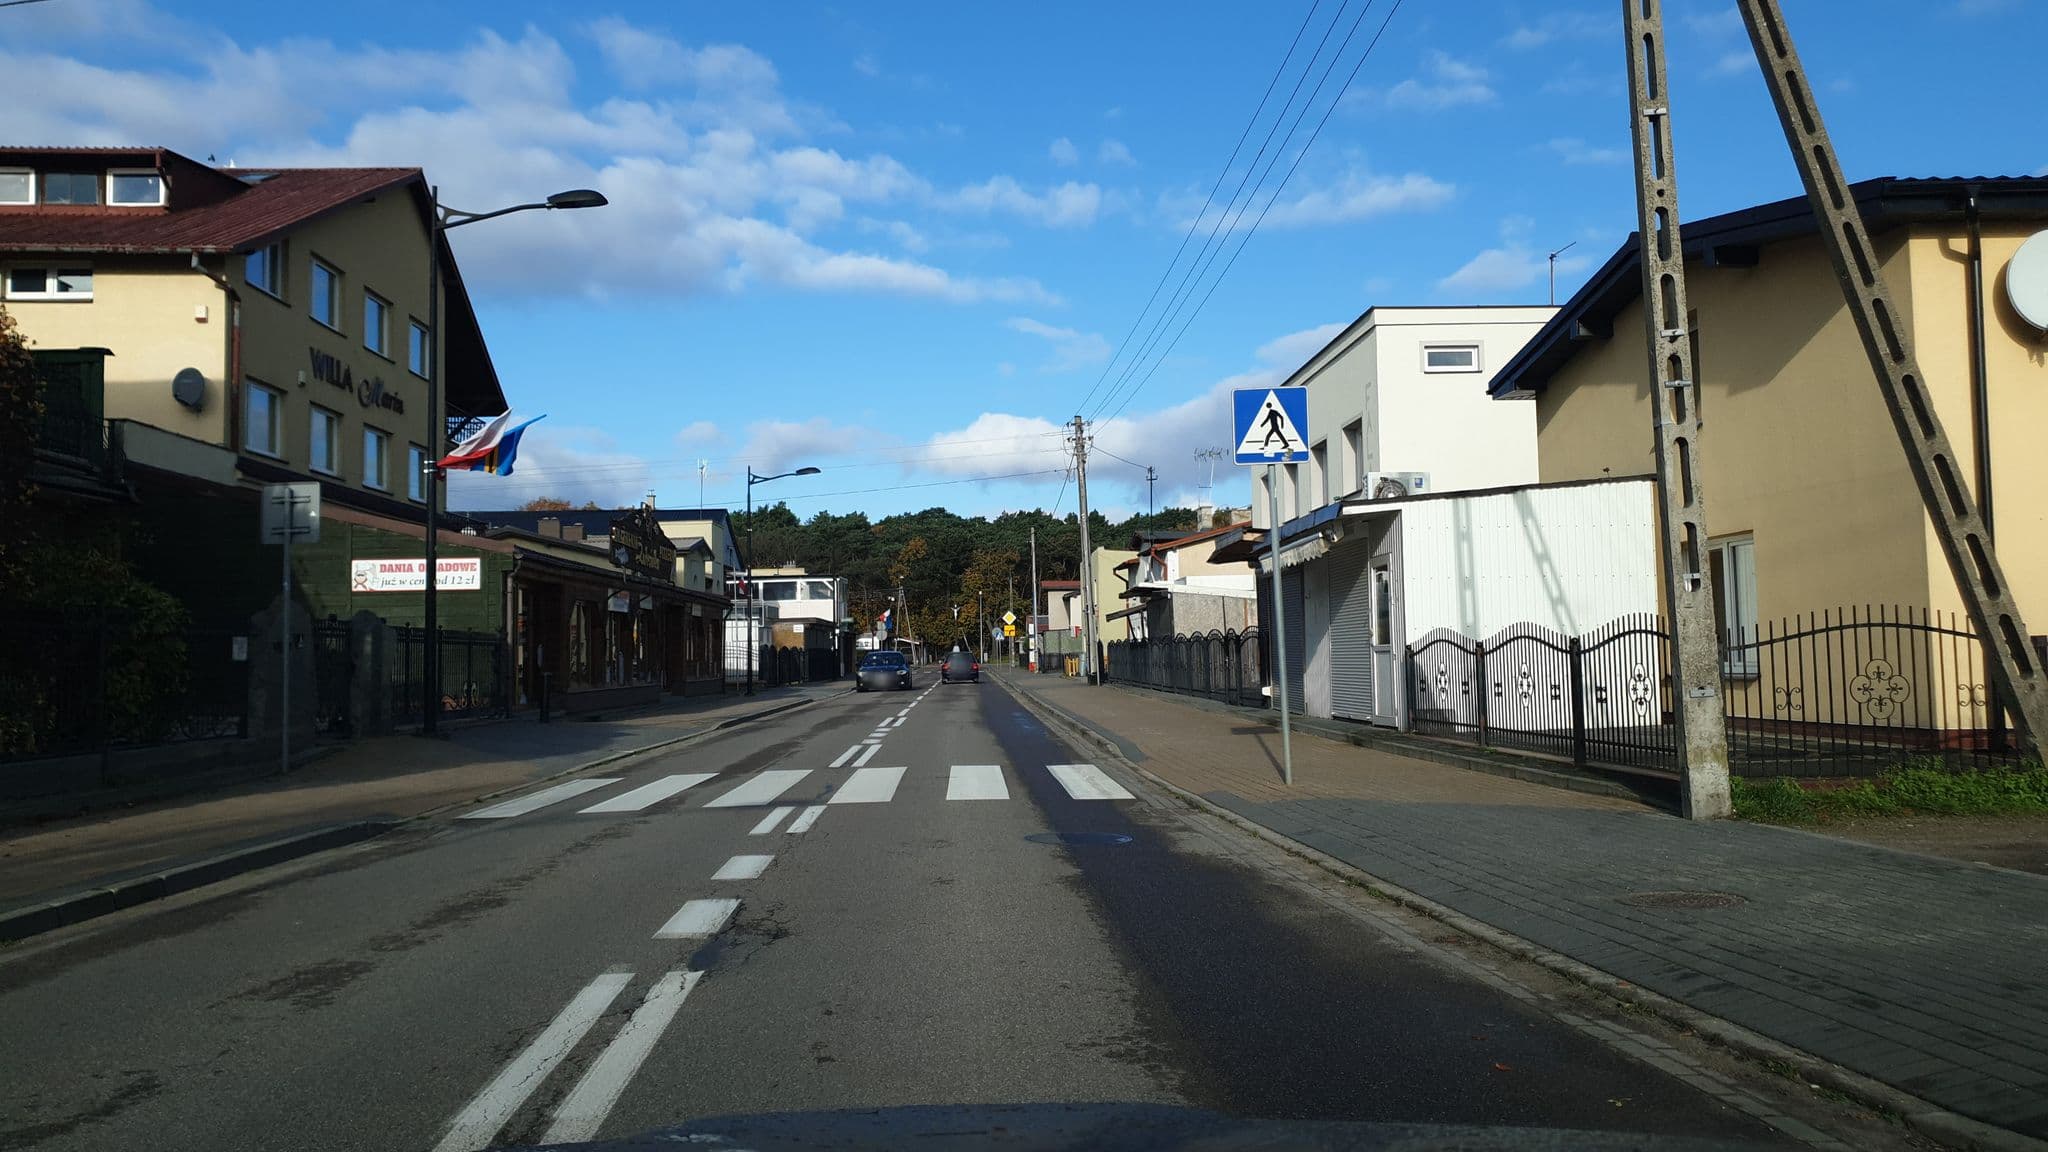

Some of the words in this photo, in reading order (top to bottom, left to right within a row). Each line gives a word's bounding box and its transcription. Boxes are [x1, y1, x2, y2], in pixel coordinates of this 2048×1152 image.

[309, 346, 353, 393] WILLA
[380, 563, 413, 573] DANIA
[418, 562, 477, 573] OADOWE
[381, 577, 397, 588] już
[451, 575, 463, 585] 12
[465, 575, 475, 585] zł
